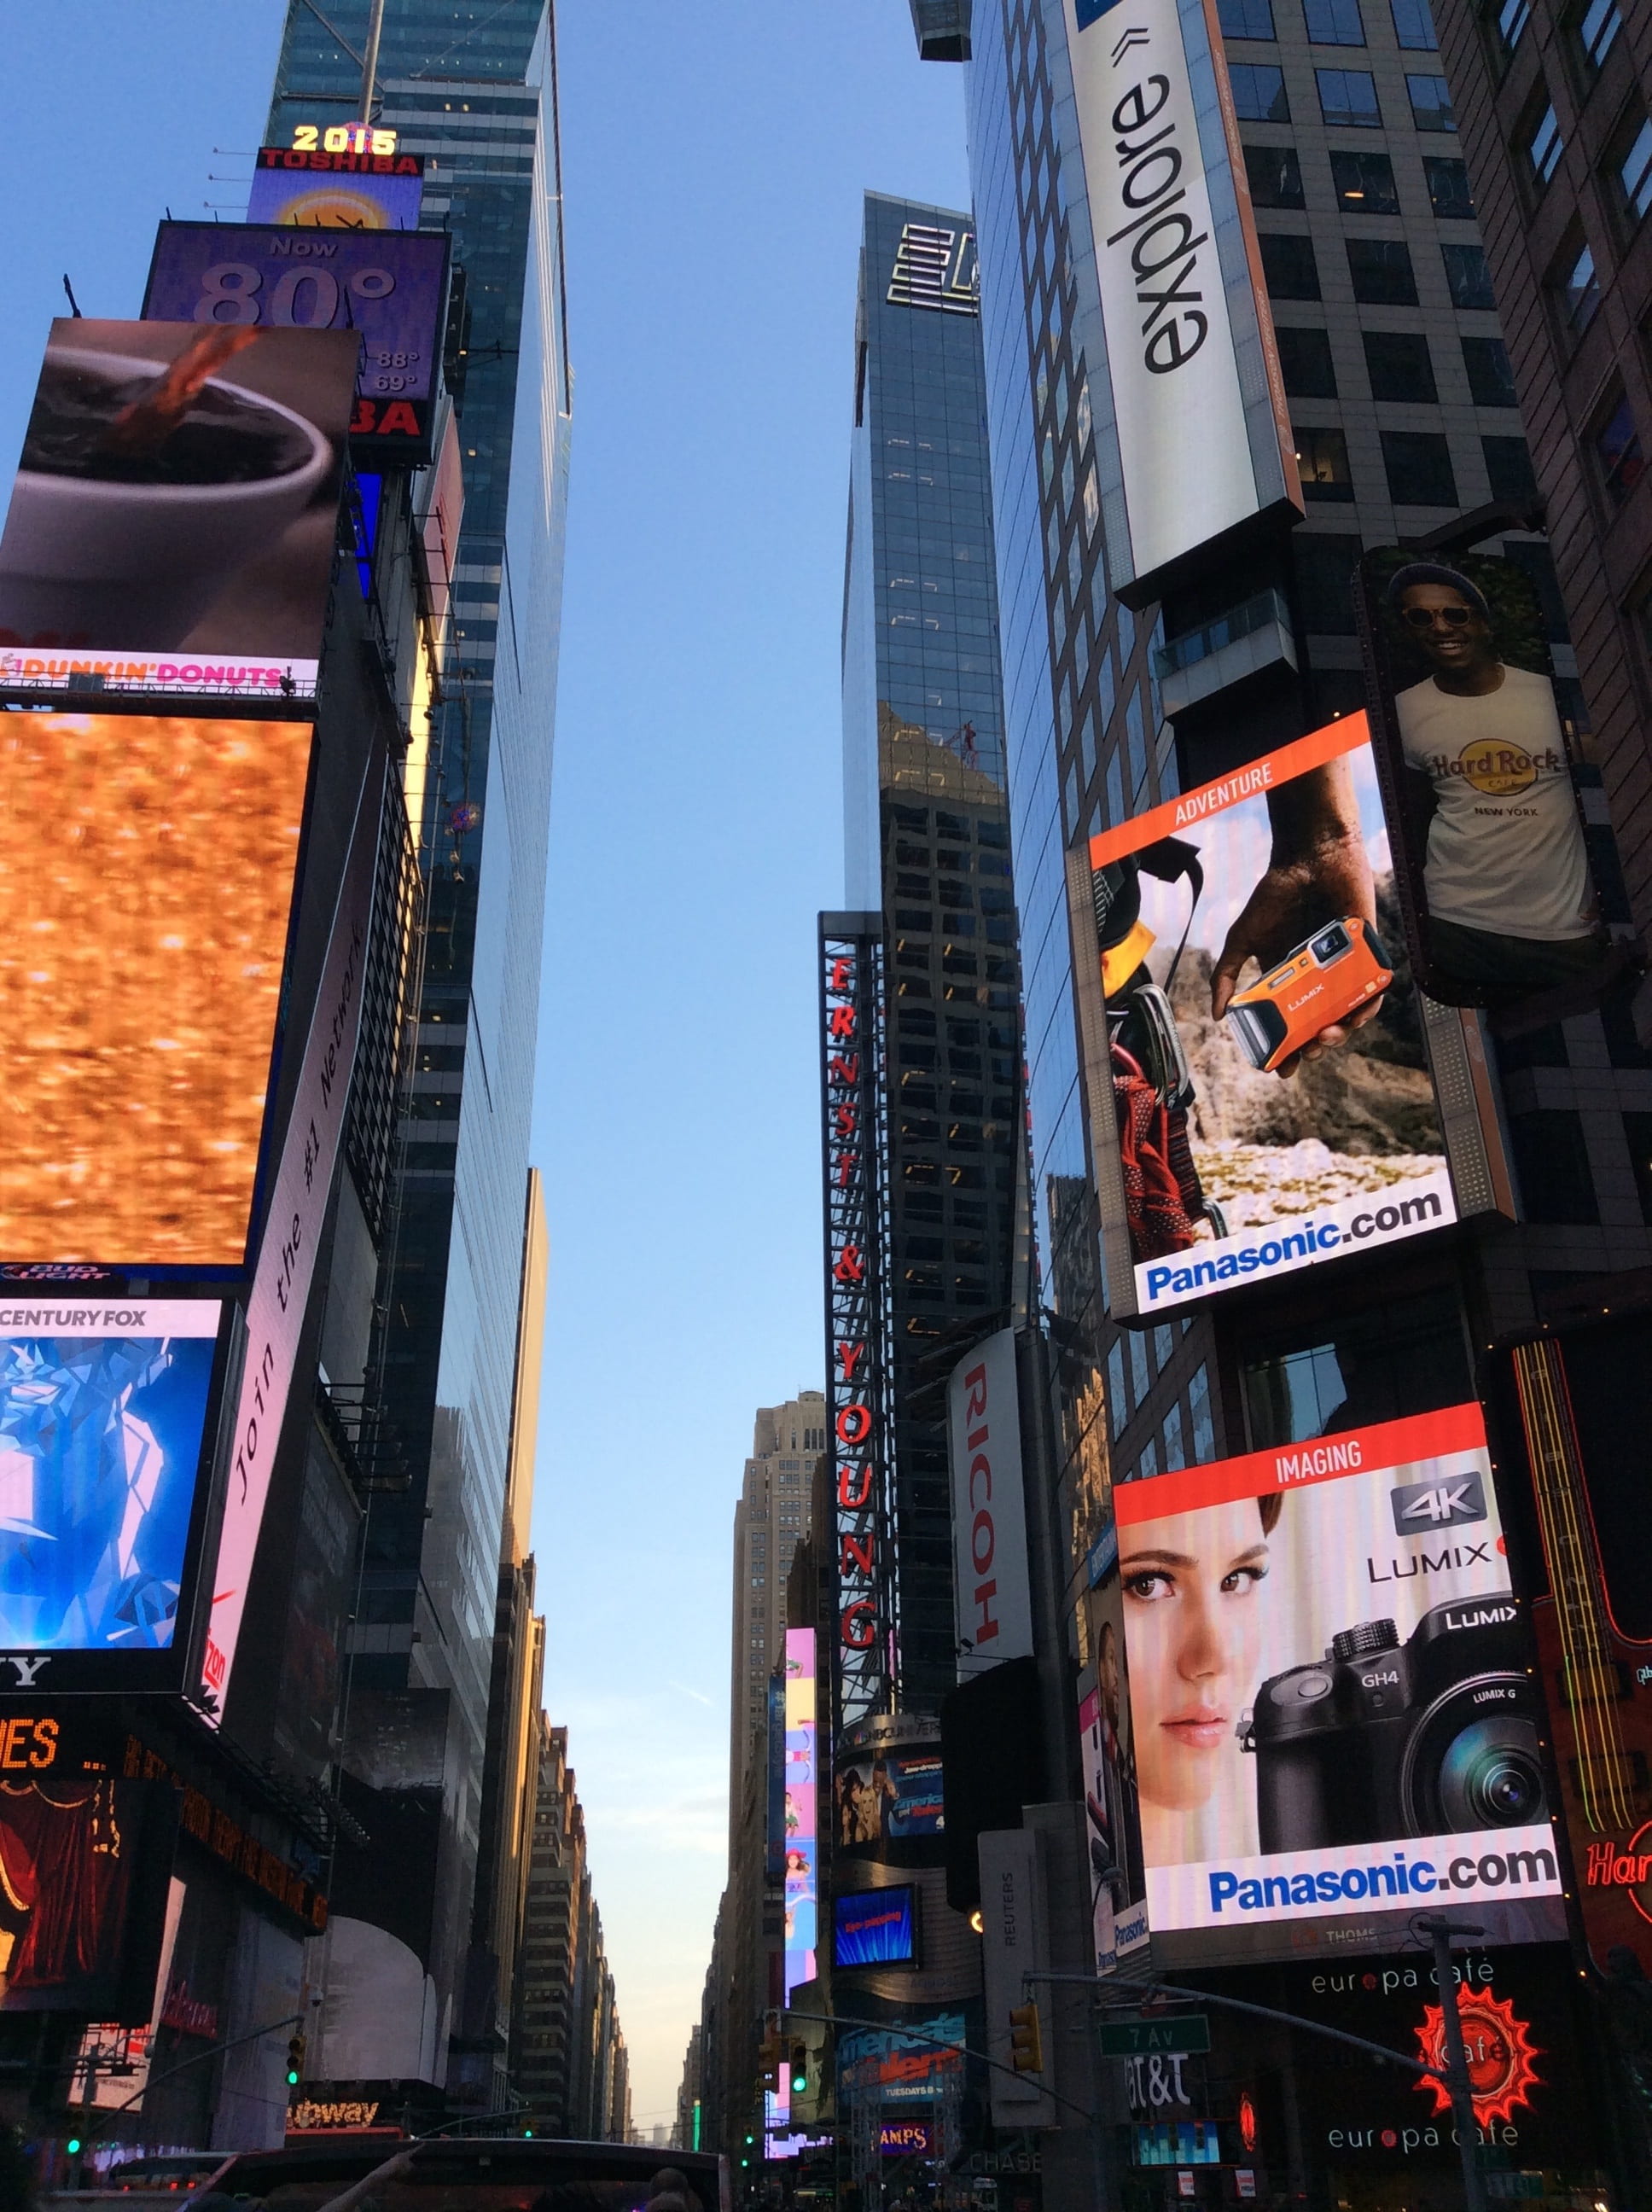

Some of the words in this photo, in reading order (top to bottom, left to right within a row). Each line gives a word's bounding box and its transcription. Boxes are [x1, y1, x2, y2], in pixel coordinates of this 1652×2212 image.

[263, 148, 419, 174] TOSHIBA
[293, 125, 398, 155] 2015
[1108, 73, 1209, 374] explore
[1256, 287, 1277, 346] REUTERS
[1265, 349, 1287, 418] THOMSON
[157, 663, 282, 687] DONUTS
[1432, 751, 1493, 777] Hard
[1496, 748, 1562, 776] Rock
[1174, 763, 1274, 825] ADVENTURE
[1474, 806, 1504, 816] NEW
[1506, 807, 1539, 817] YORK
[1288, 983, 1325, 1012] LUMIX
[829, 957, 855, 1189] ERNST
[236, 1341, 275, 1506] Join
[277, 1212, 301, 1313] the
[318, 923, 364, 1109] Network
[835, 1243, 864, 1284] &
[1147, 1191, 1441, 1301] Panasonic.com
[102, 1309, 146, 1327] FOX
[1276, 1441, 1363, 1484] IMAGING
[836, 1341, 875, 1650] YOUNG
[963, 1362, 999, 1647] RICOH
[1400, 1488, 1480, 1522] 4K
[1367, 1541, 1492, 1584] LUMIX
[1361, 1669, 1400, 1689] GH4
[1473, 1688, 1506, 1704] LUMIX
[1507, 1689, 1517, 1699] G
[1209, 1848, 1559, 1912] Panasonic.com
[1002, 1871, 1014, 1947] REUTERS
[1128, 2028, 1140, 2048] 7
[885, 2087, 927, 2097] TUESDAYS
